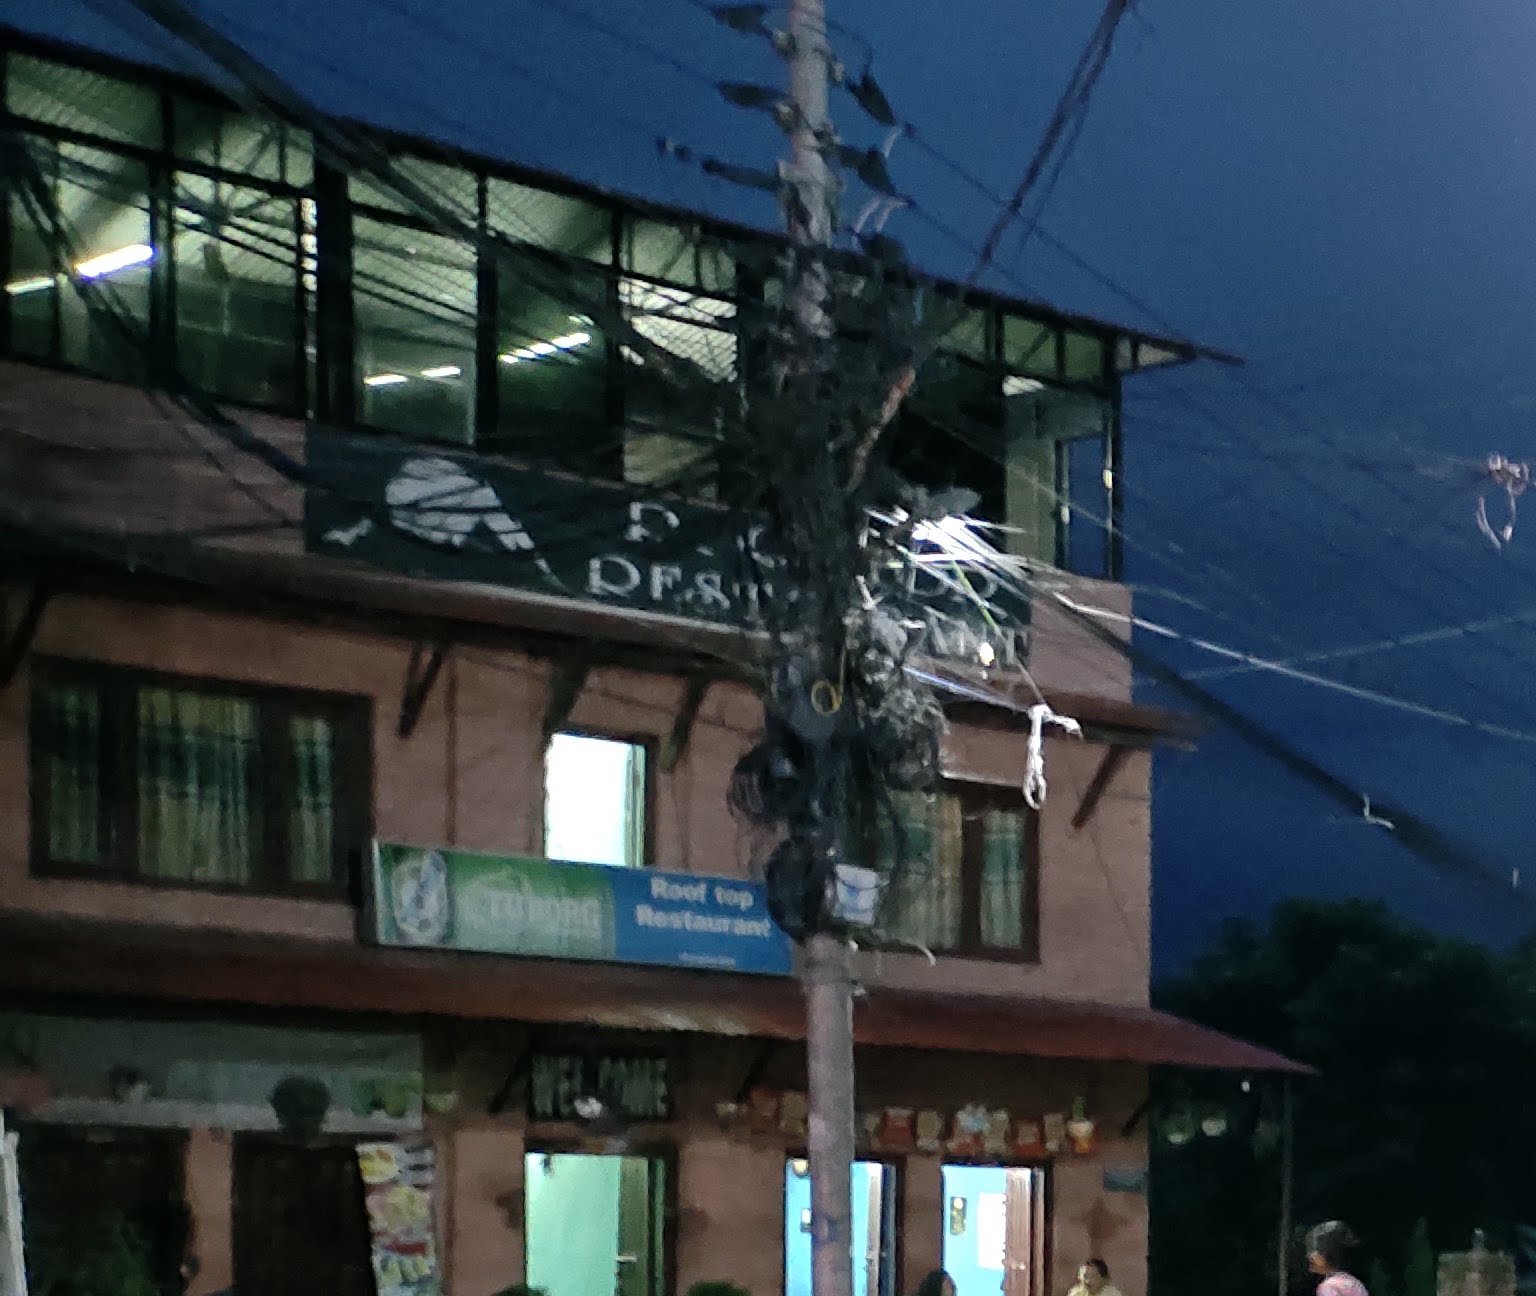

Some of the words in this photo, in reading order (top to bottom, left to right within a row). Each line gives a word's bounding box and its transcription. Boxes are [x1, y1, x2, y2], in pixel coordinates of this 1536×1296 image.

[650, 876, 707, 903] Roof
[714, 886, 754, 911] top
[635, 904, 771, 937] Restaurant
